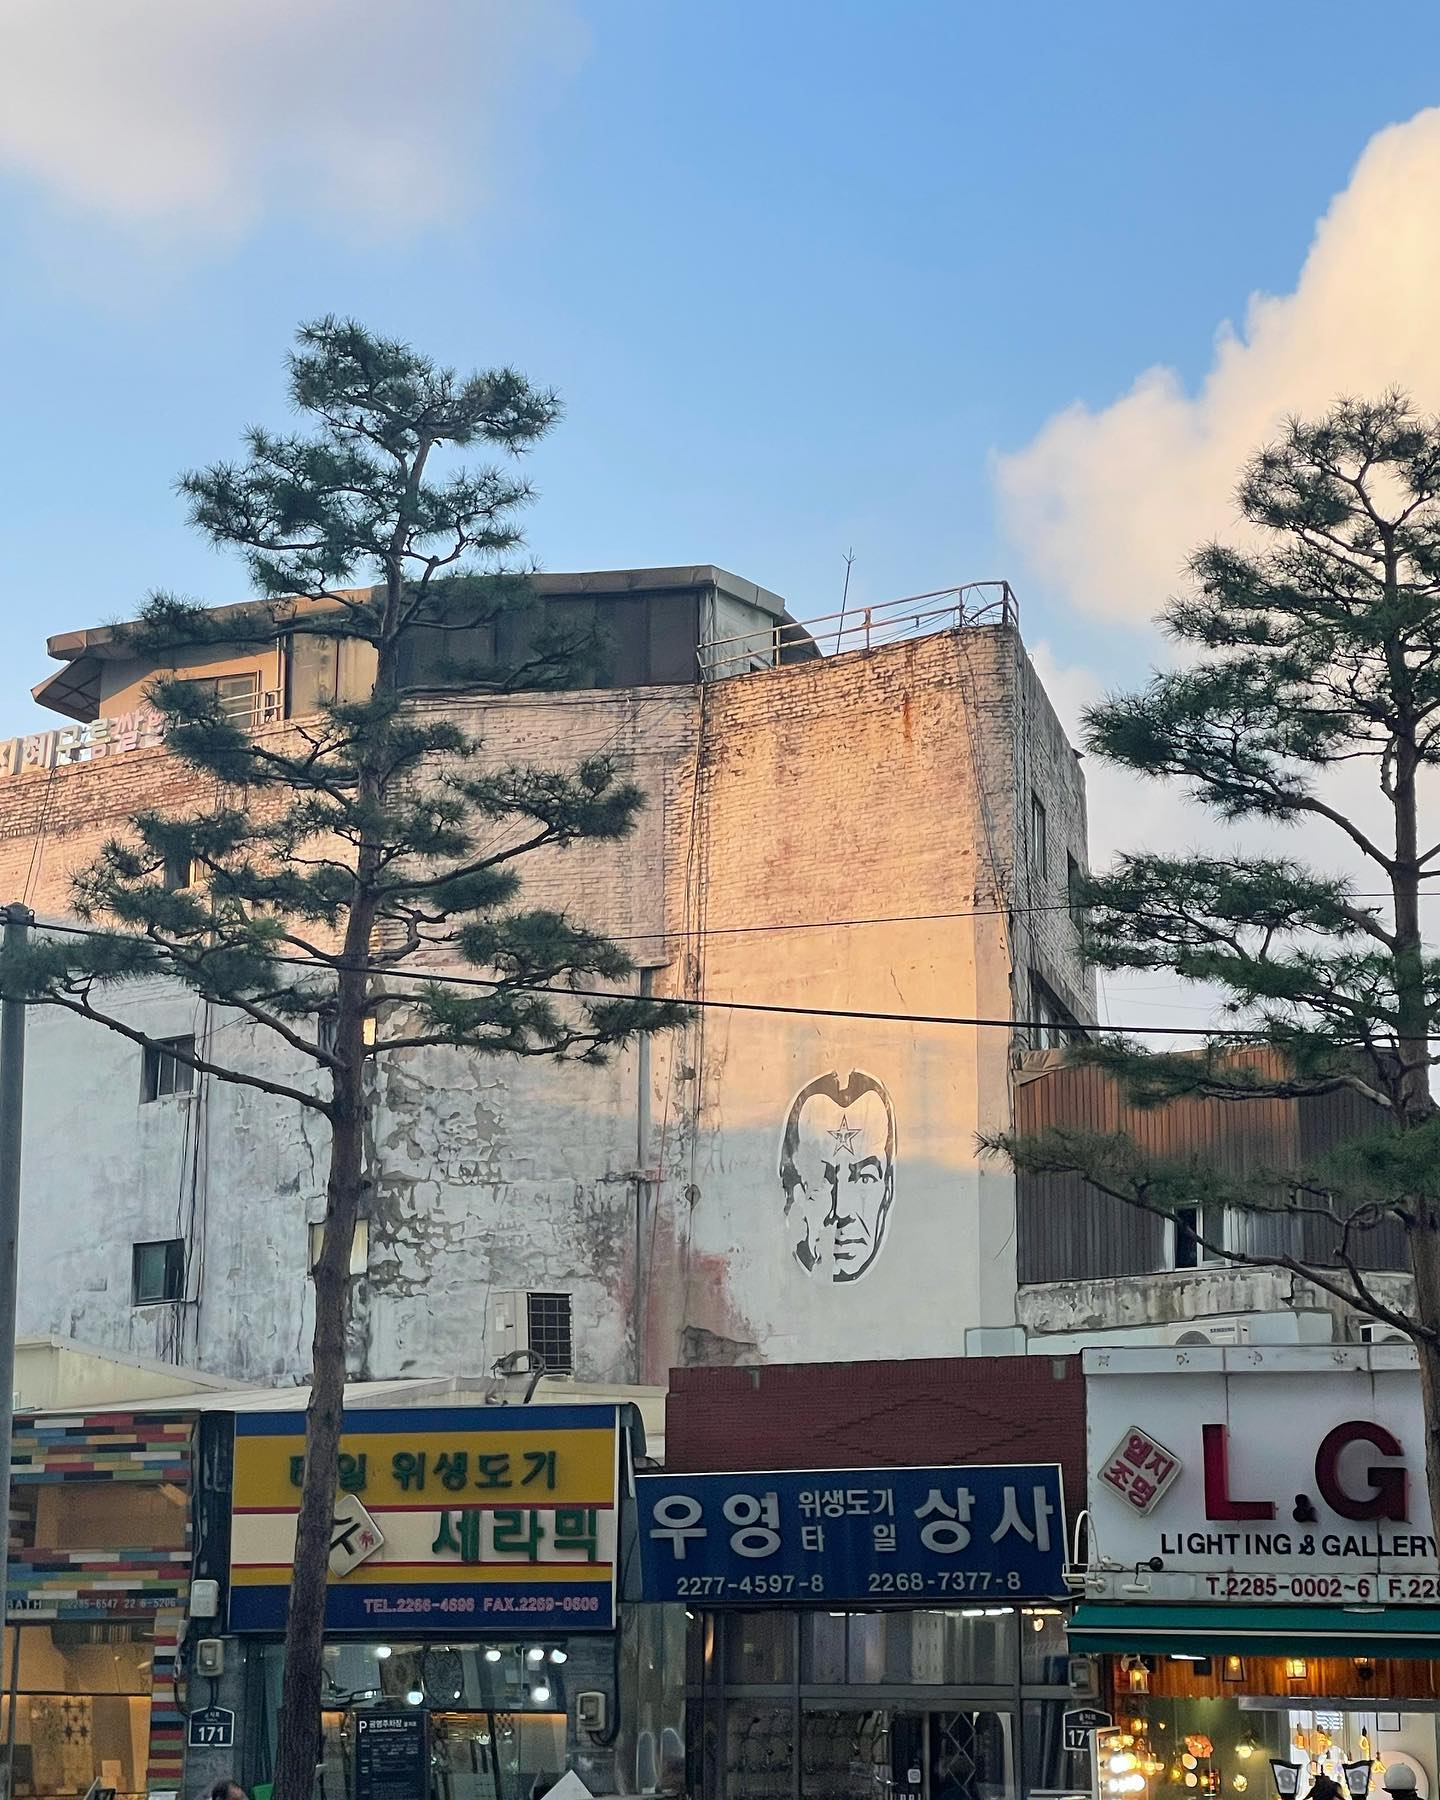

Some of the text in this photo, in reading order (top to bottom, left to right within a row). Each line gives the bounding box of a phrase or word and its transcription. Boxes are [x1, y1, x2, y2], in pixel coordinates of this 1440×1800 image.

[391, 1450, 557, 1491] 위생도기
[1123, 1434, 1175, 1485] 엘지
[798, 1489, 895, 1518] 위생도기
[1103, 1459, 1158, 1508] 조명
[432, 1508, 597, 1563] 세라믹
[650, 1491, 781, 1560] 우영
[913, 1485, 1054, 1554] 상사
[1160, 1533, 1292, 1555] LIGHTING
[1299, 1535, 1316, 1556] &
[676, 1571, 1022, 1596] 2277-4597-8 2268-7377-8
[199, 1726, 224, 1742] 171
[1068, 1729, 1093, 1746] 17
